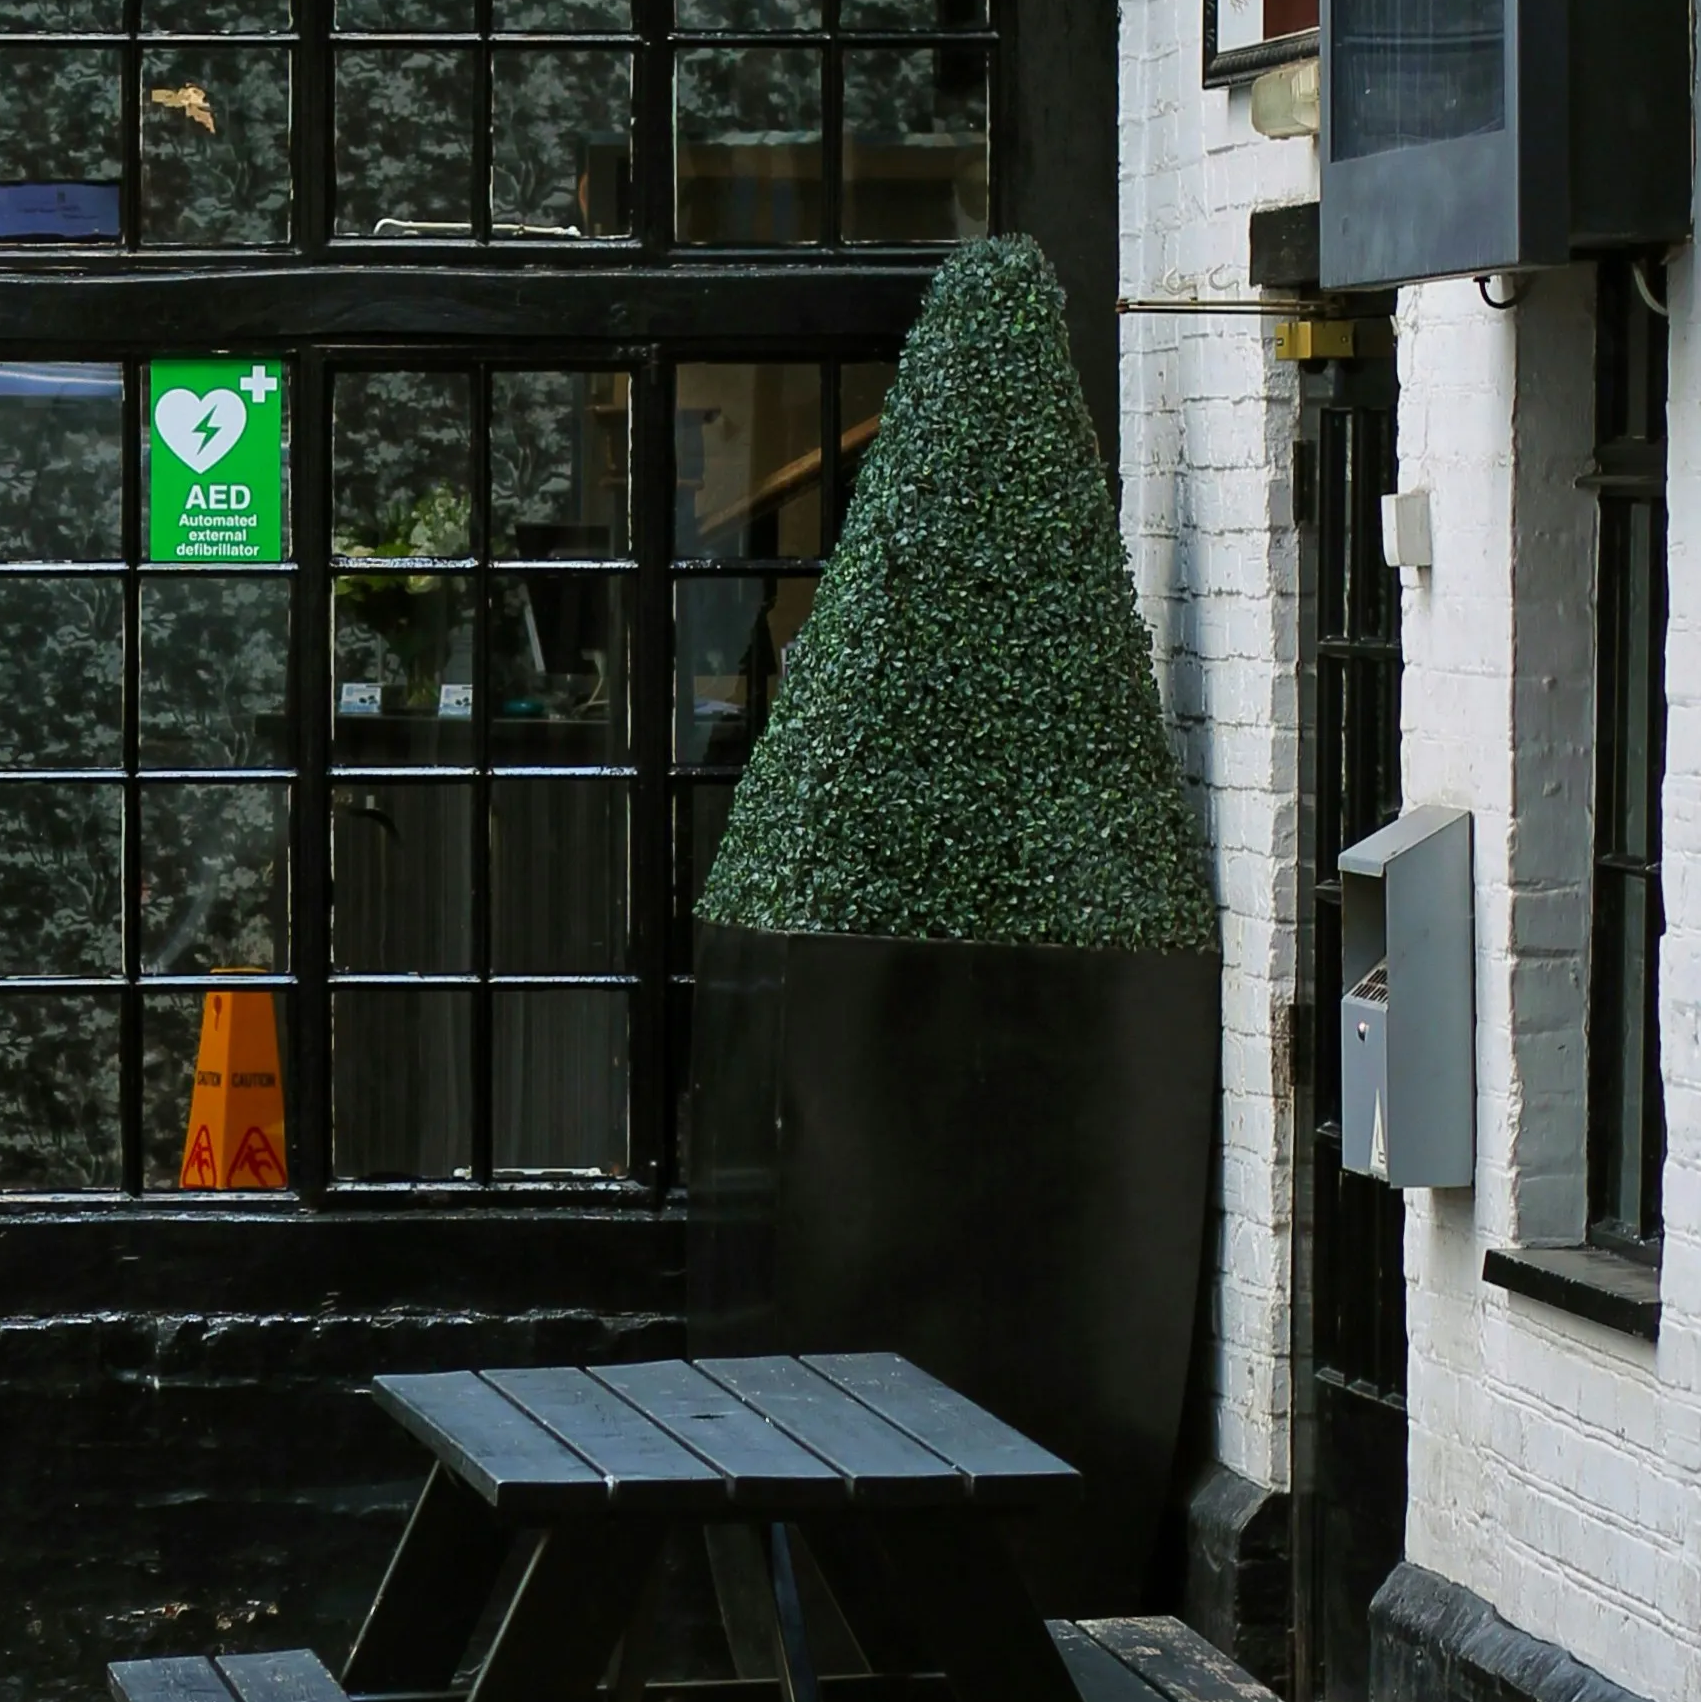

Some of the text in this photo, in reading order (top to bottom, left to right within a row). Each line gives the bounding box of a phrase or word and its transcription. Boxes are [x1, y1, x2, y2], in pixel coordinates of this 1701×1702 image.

[185, 484, 251, 509] AED
[178, 514, 257, 527] Automated
[188, 529, 247, 541] external
[176, 543, 259, 556] defibrillator
[231, 1071, 276, 1088] CAUTION
